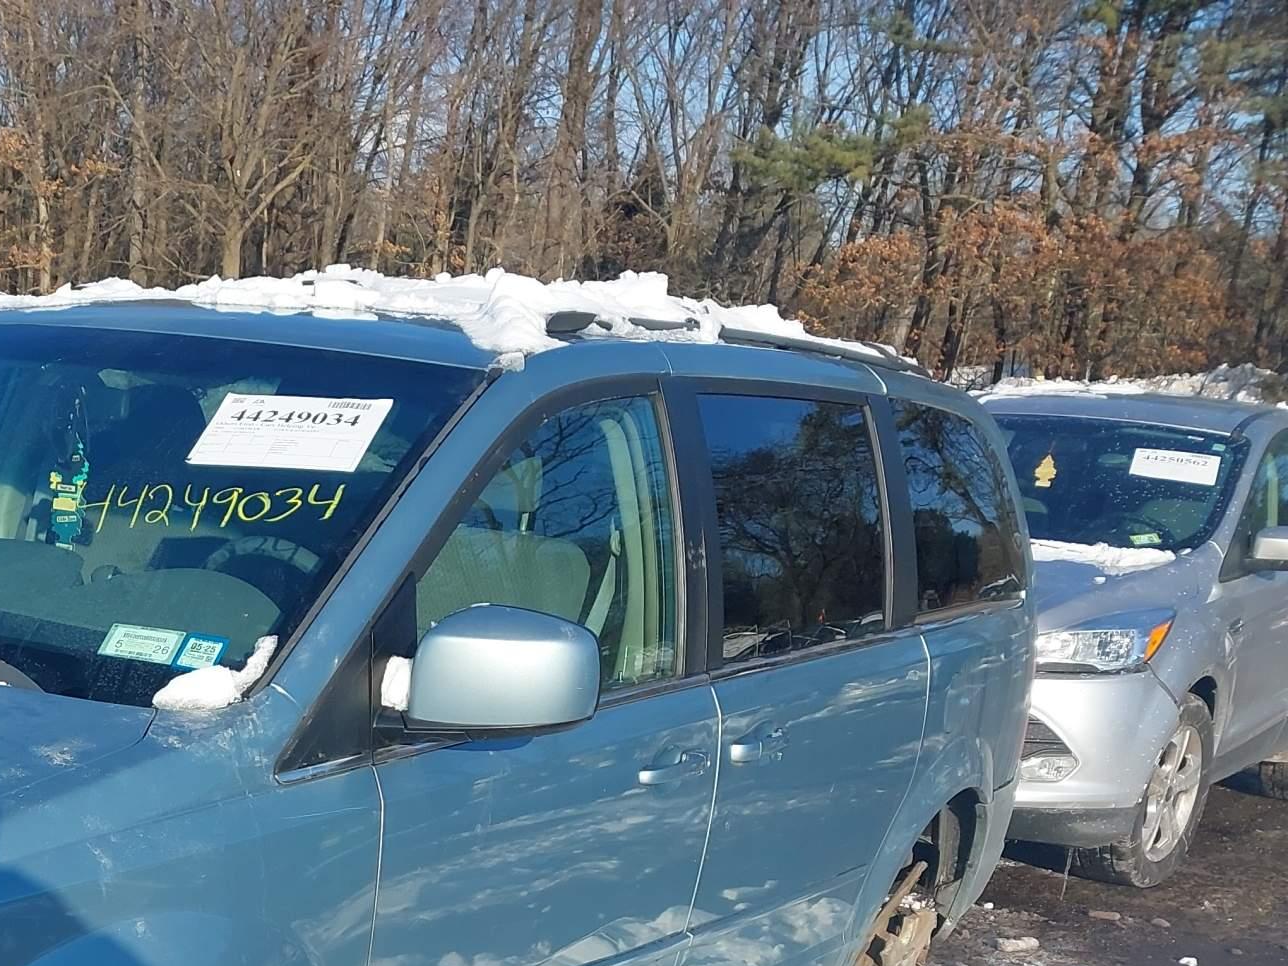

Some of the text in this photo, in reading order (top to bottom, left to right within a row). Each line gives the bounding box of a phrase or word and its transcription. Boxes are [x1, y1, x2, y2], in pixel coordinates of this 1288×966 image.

[230, 408, 362, 427] 44249034
[77, 481, 347, 534] 44249034
[152, 644, 170, 655] 26
